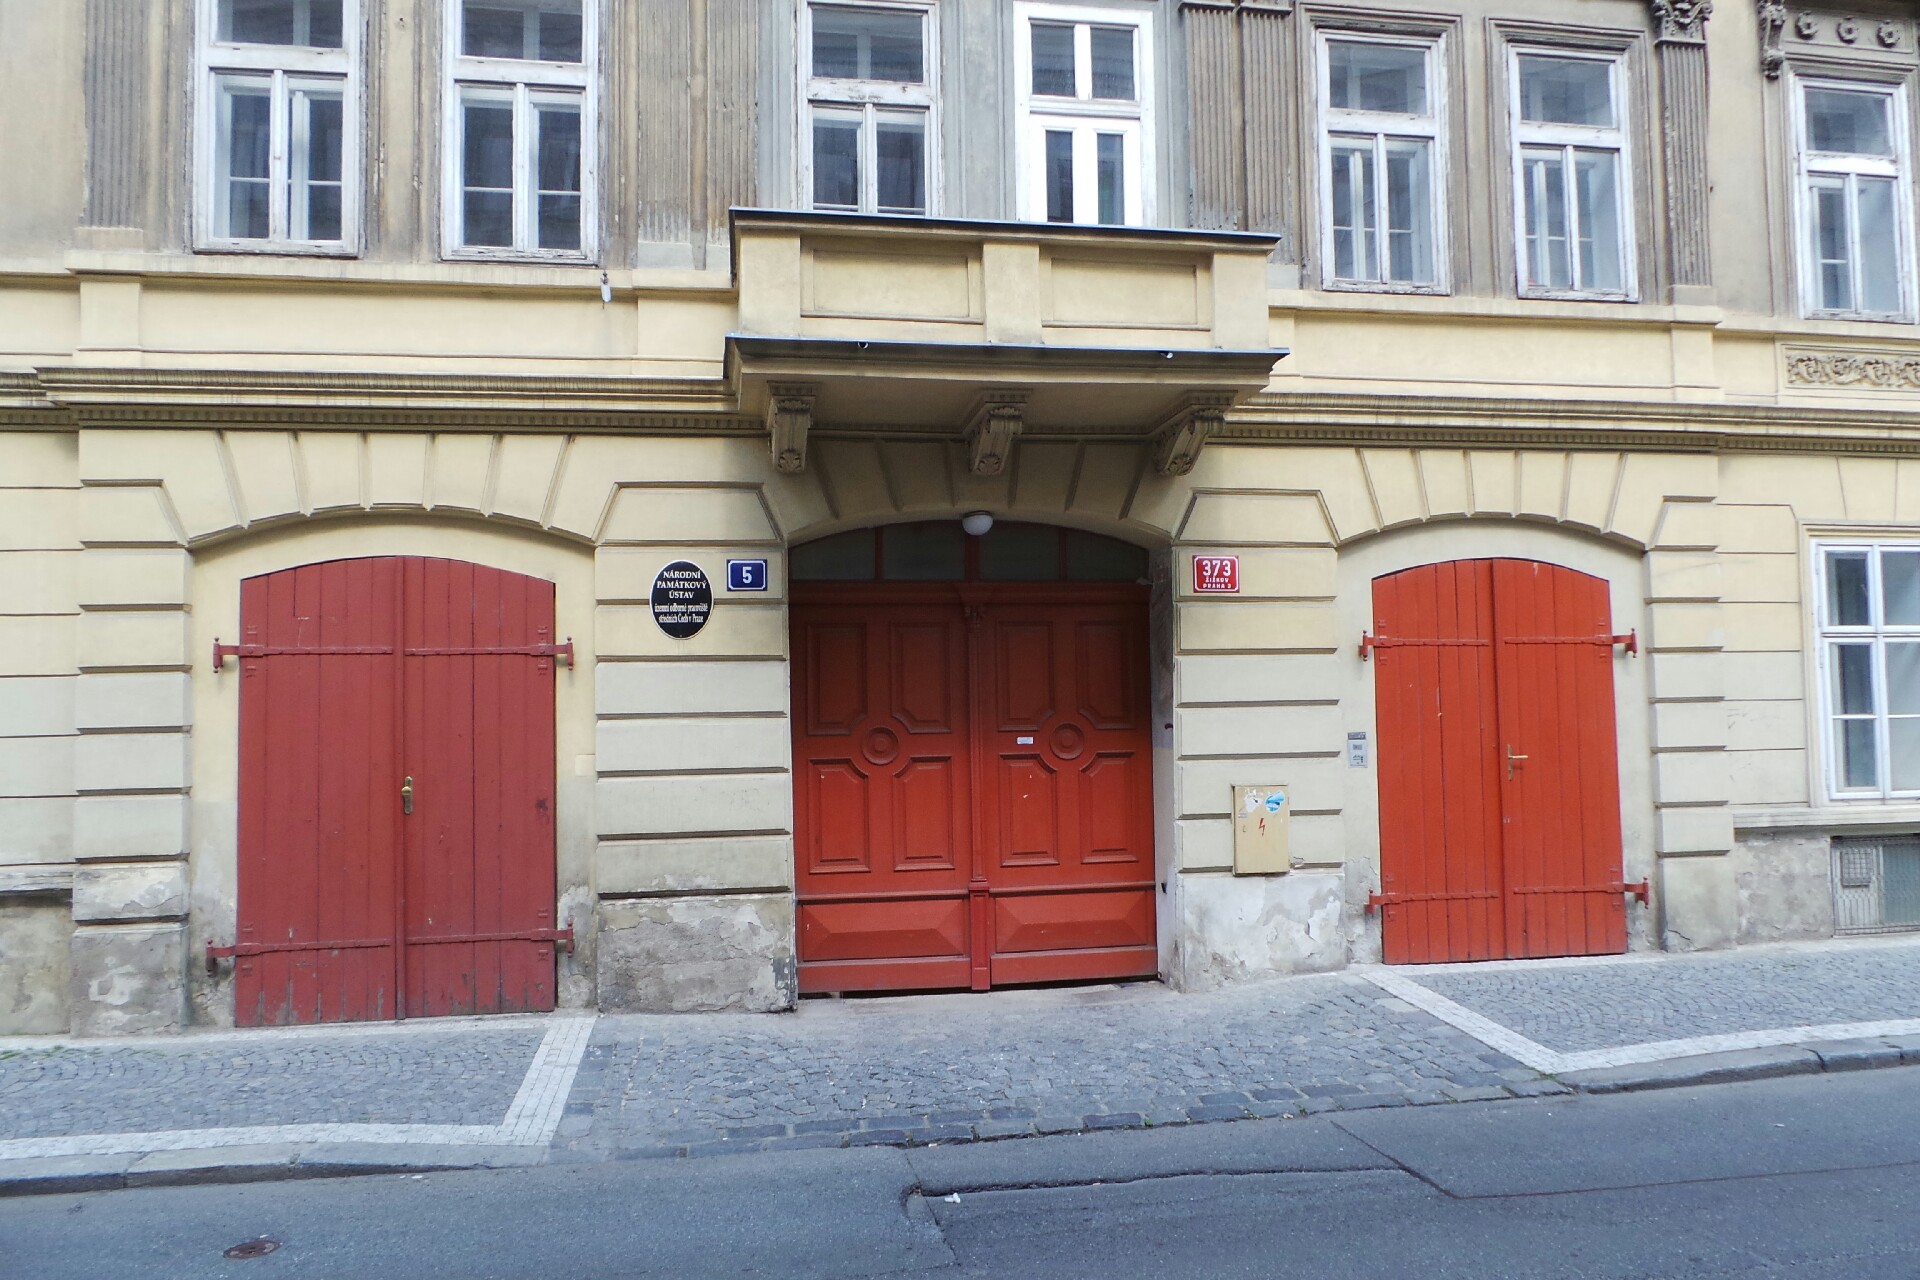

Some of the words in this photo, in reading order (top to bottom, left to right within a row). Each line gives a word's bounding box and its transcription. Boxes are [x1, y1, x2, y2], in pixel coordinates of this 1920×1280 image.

[1202, 560, 1231, 577] 373
[663, 570, 701, 579] NÁRODNÍ
[742, 566, 752, 584] 5
[656, 580, 706, 589] PAMÁTKOVÝ
[669, 590, 694, 598] ÚSTAV
